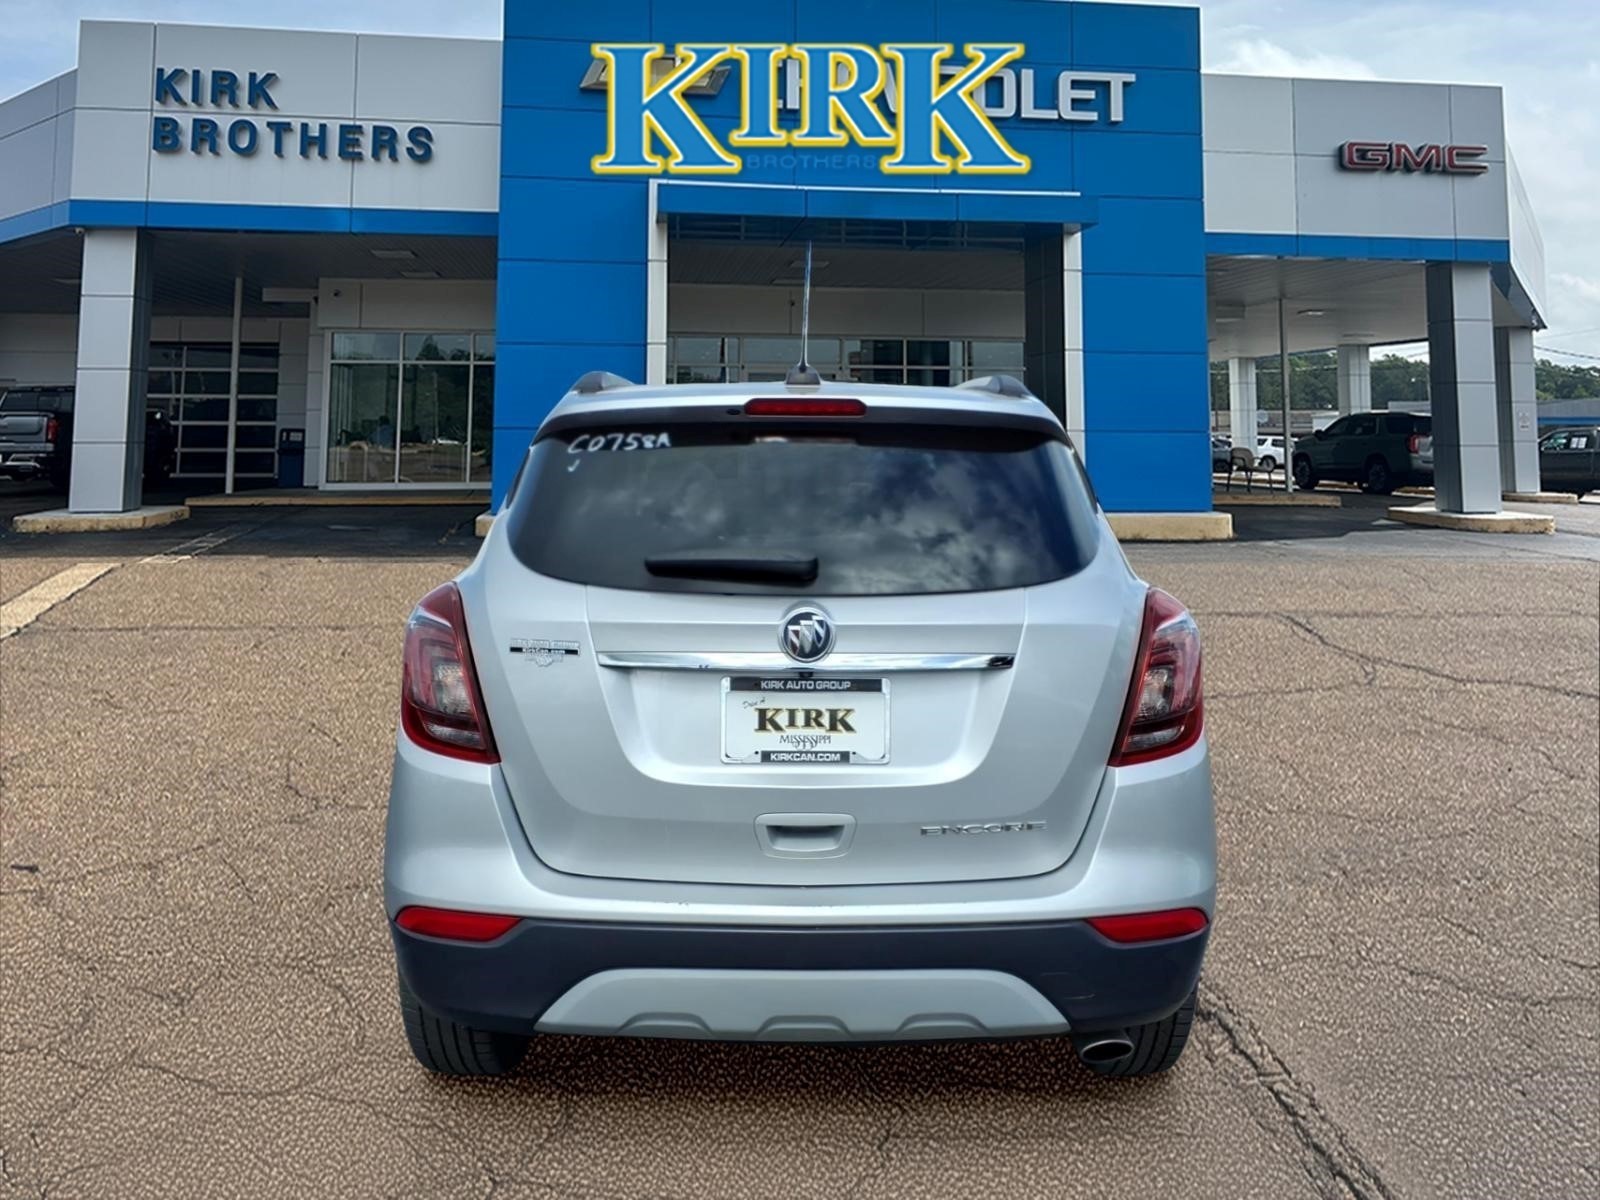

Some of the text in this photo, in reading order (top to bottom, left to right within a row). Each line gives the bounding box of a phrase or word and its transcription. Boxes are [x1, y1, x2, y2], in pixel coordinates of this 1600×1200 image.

[155, 67, 279, 110] KIRK
[153, 116, 434, 164] BROTHERS
[1340, 141, 1489, 174] GMC
[761, 680, 851, 690] KIRK AUTO GROUP
[754, 707, 857, 733] KIRK
[770, 752, 841, 762] KIRKCAN.COM
[920, 821, 1048, 836] ENCORE
